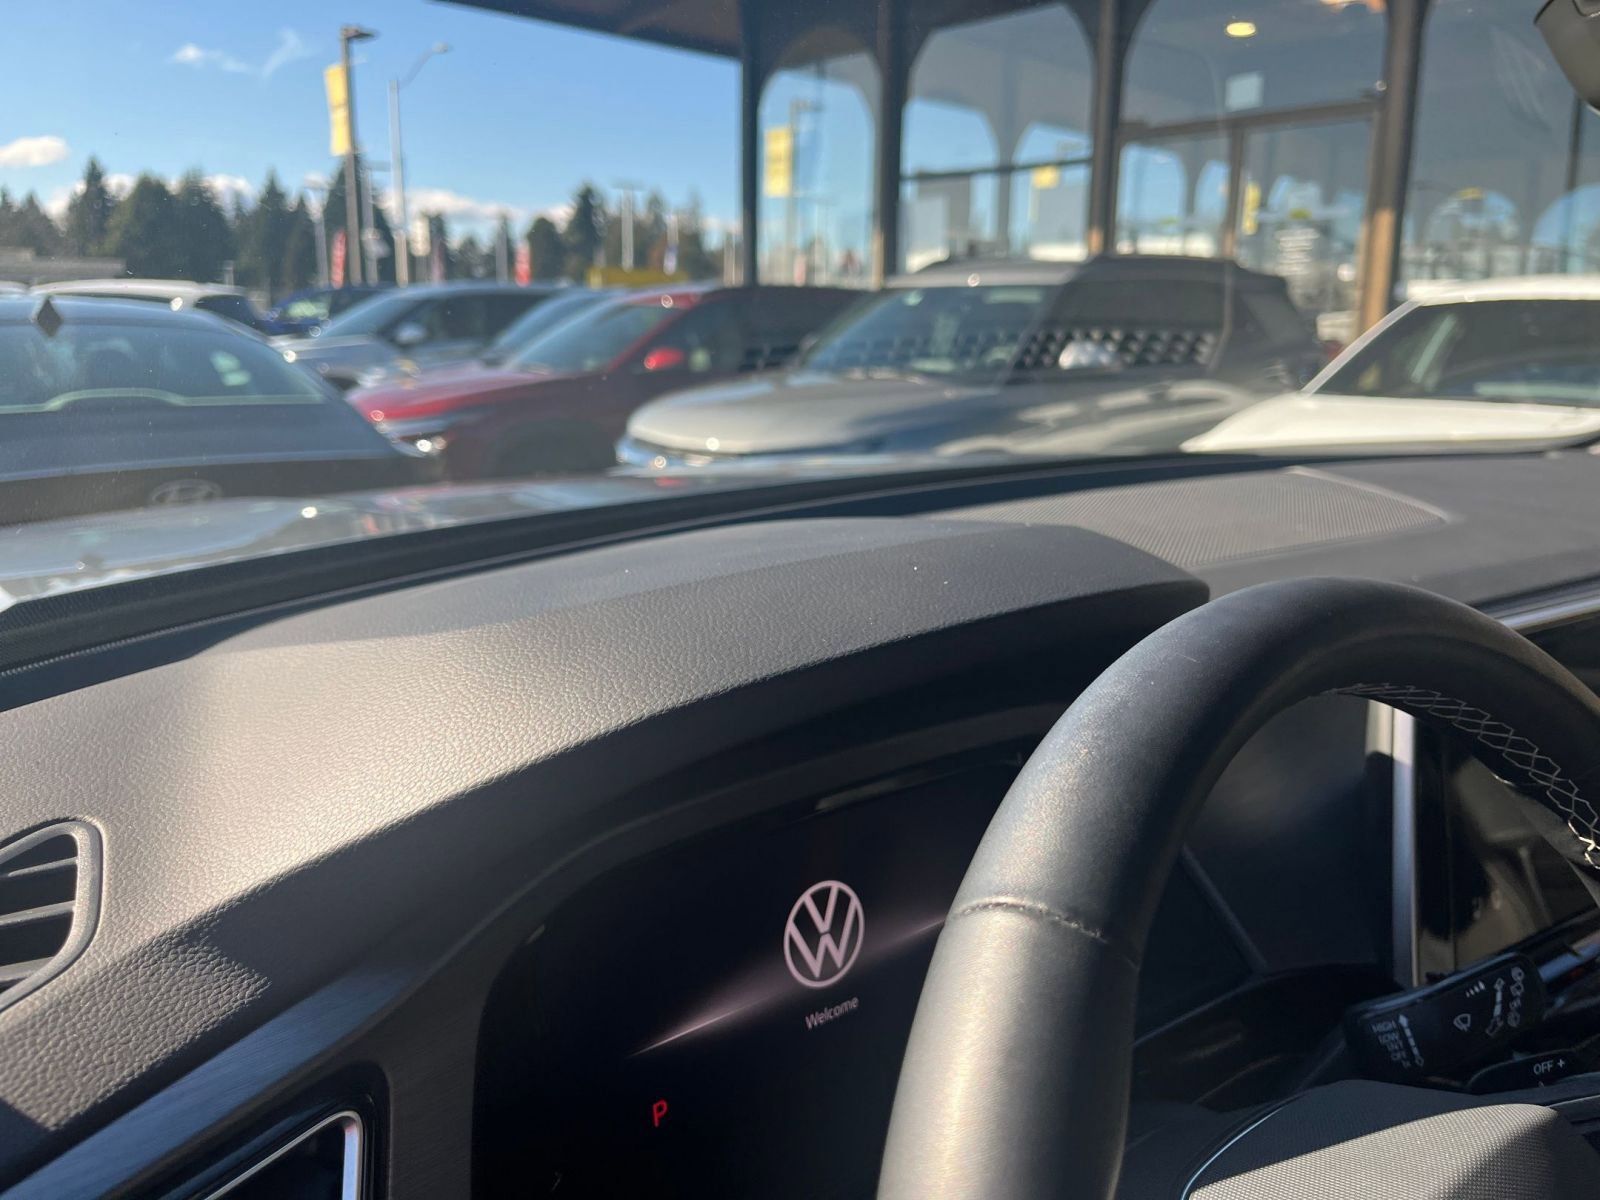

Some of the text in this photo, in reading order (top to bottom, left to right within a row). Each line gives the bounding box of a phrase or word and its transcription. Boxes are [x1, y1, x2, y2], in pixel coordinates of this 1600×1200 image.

[784, 880, 864, 987] VW
[805, 997, 858, 1029] Welcome
[1533, 1060, 1553, 1075] OFF
[652, 1099, 668, 1127] P
